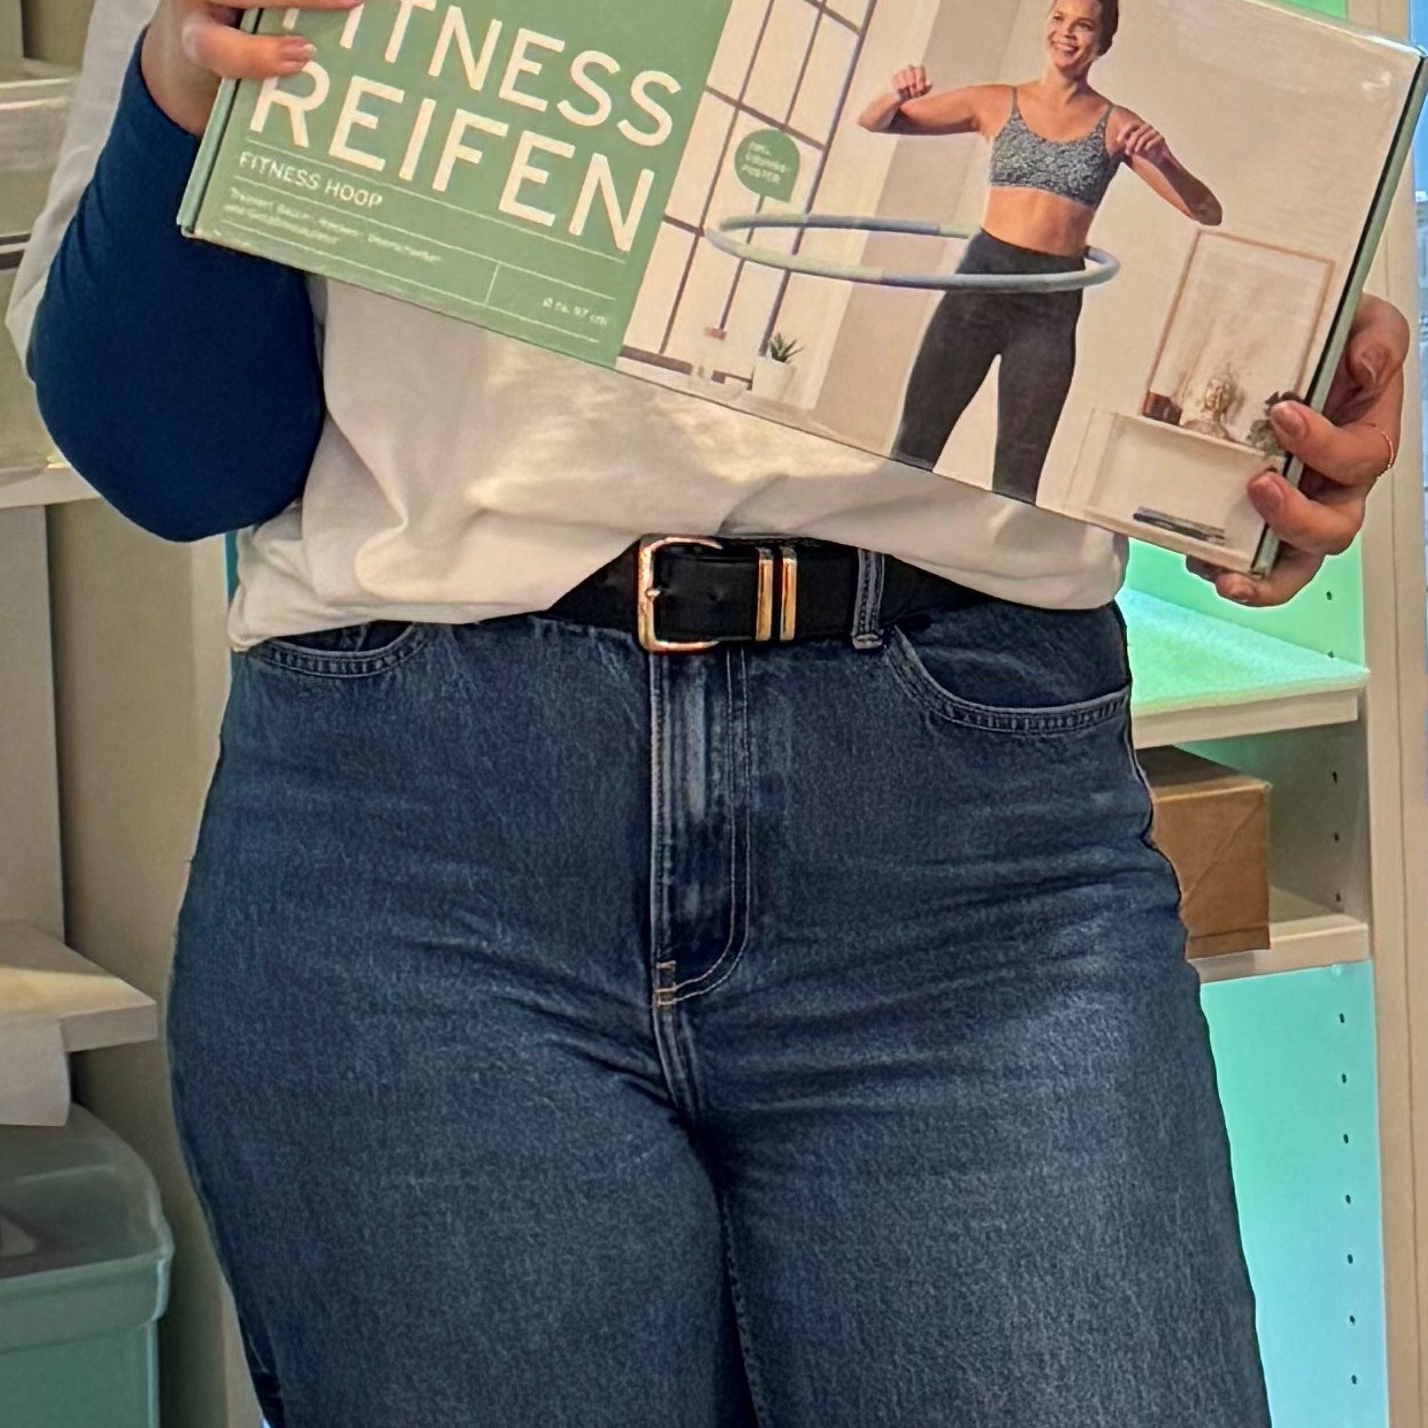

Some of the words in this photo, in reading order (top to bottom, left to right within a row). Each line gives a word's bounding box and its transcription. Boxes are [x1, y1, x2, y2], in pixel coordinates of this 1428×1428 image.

[239, 152, 320, 193] FITNESS
[324, 178, 384, 210] HOOP
[249, 59, 657, 254] REIFEN
